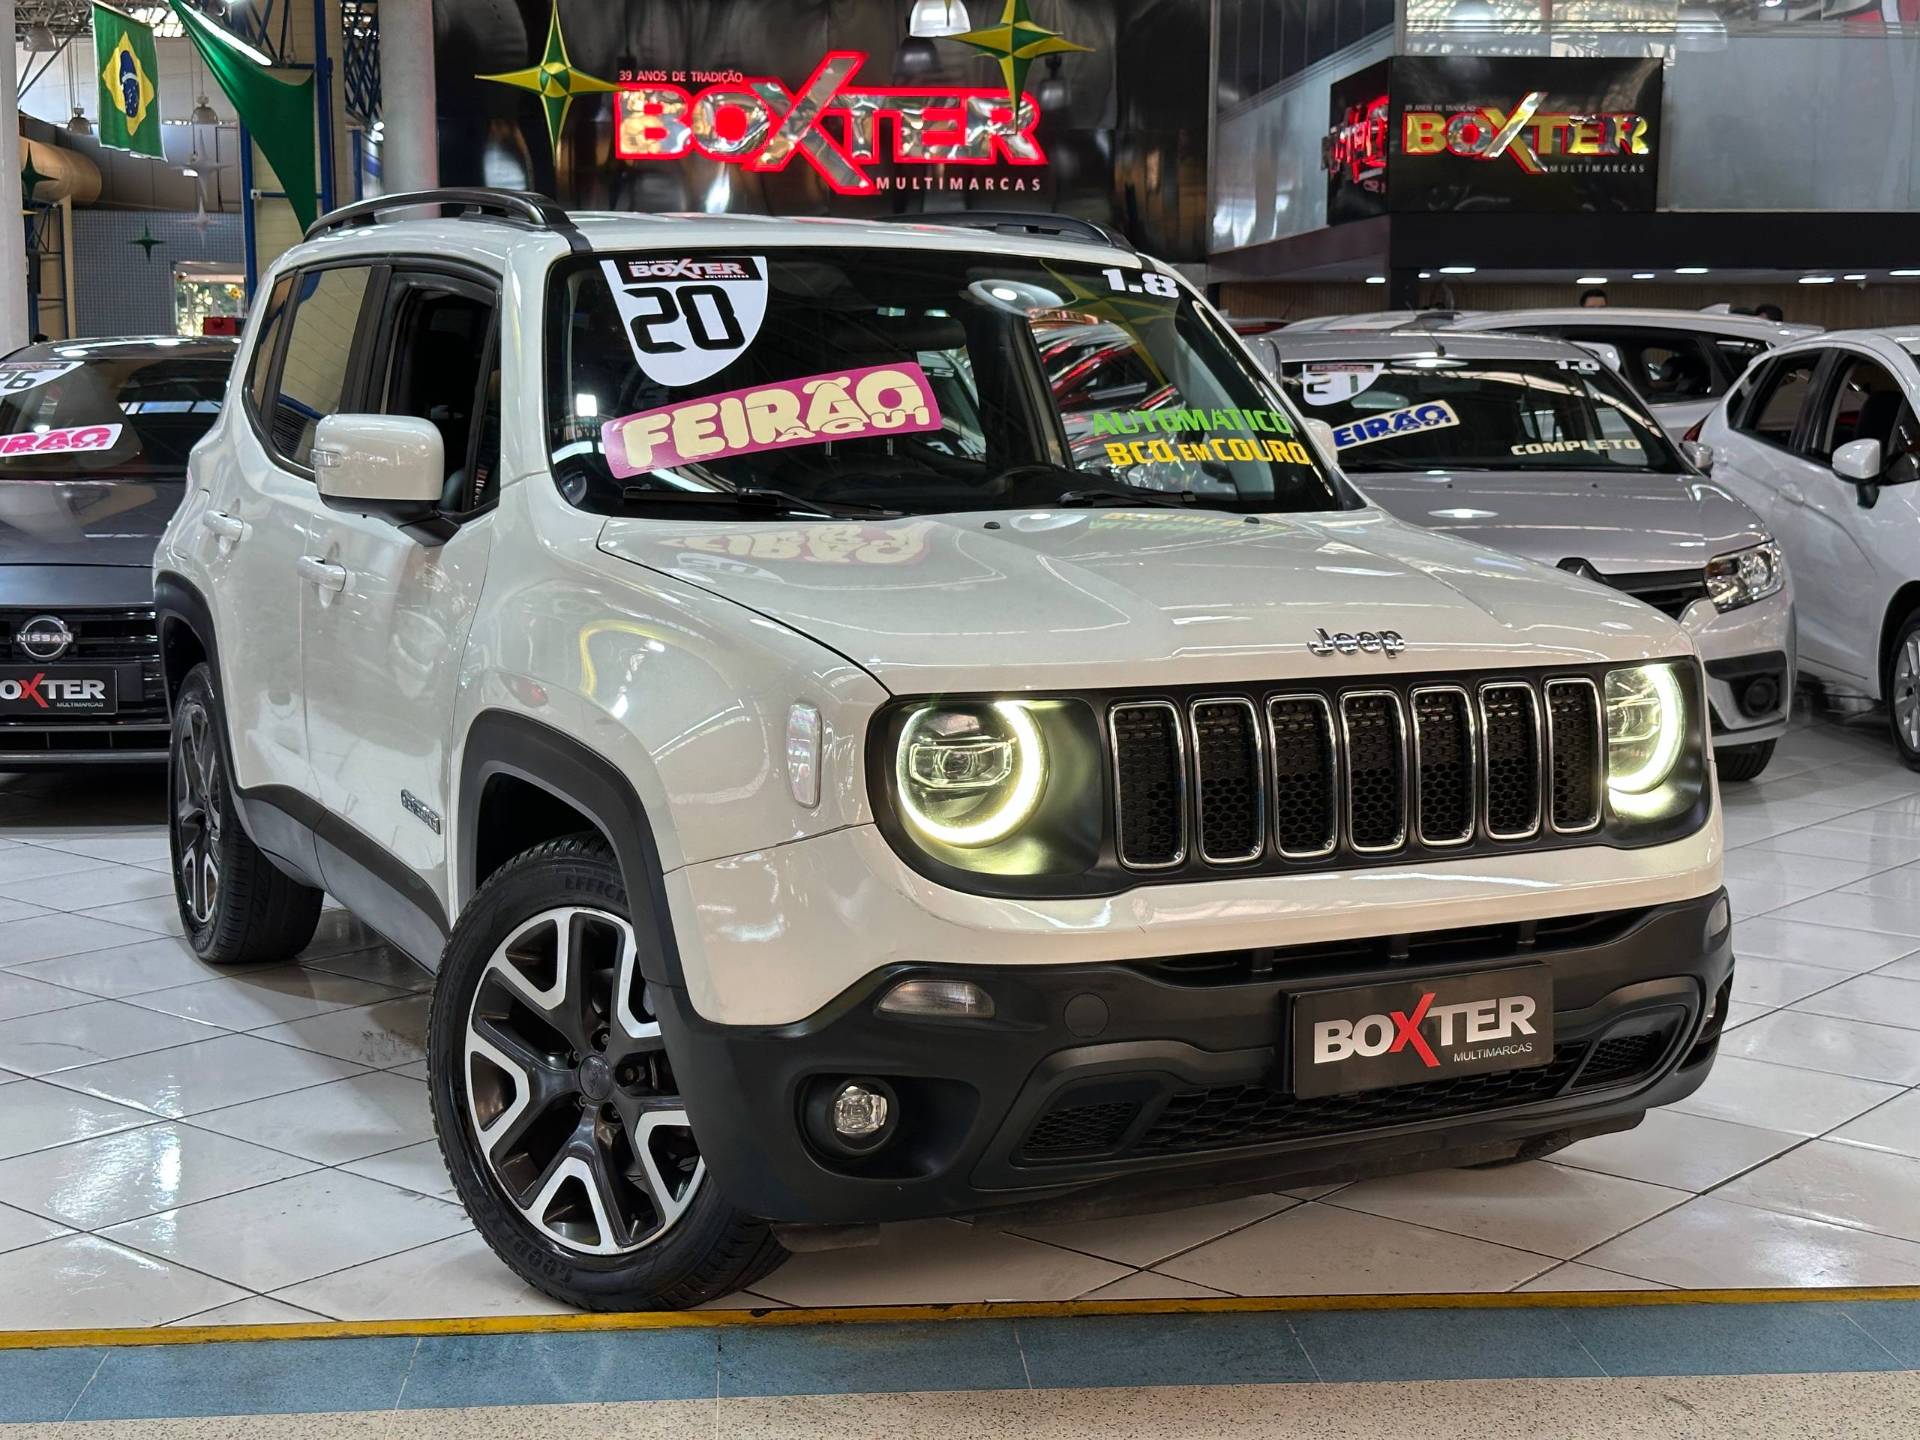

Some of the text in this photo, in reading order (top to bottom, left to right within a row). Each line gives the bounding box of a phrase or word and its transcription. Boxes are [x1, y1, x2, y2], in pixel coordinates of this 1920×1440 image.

[619, 69, 744, 84] 39 ANOS DE TRADIÇÃO
[614, 50, 1049, 195] BOXTER
[1402, 91, 1650, 174] BOXTER
[1549, 164, 1646, 173] MULTIMARCAS
[876, 177, 1042, 191] MULTIMARCAS
[628, 258, 747, 280] BOXTER
[1101, 268, 1180, 299] 1.8
[622, 284, 746, 355] 20
[622, 370, 926, 468] FEIRÃO
[1177, 443, 1214, 462] EM
[1208, 438, 1312, 465] COURO
[1510, 439, 1642, 456] COMPLETO
[16, 633, 73, 643] NISSAN
[1306, 628, 1406, 659] Jeep
[1313, 992, 1537, 1068] BOXTER
[1453, 1041, 1534, 1063] MULTIMARCAS
